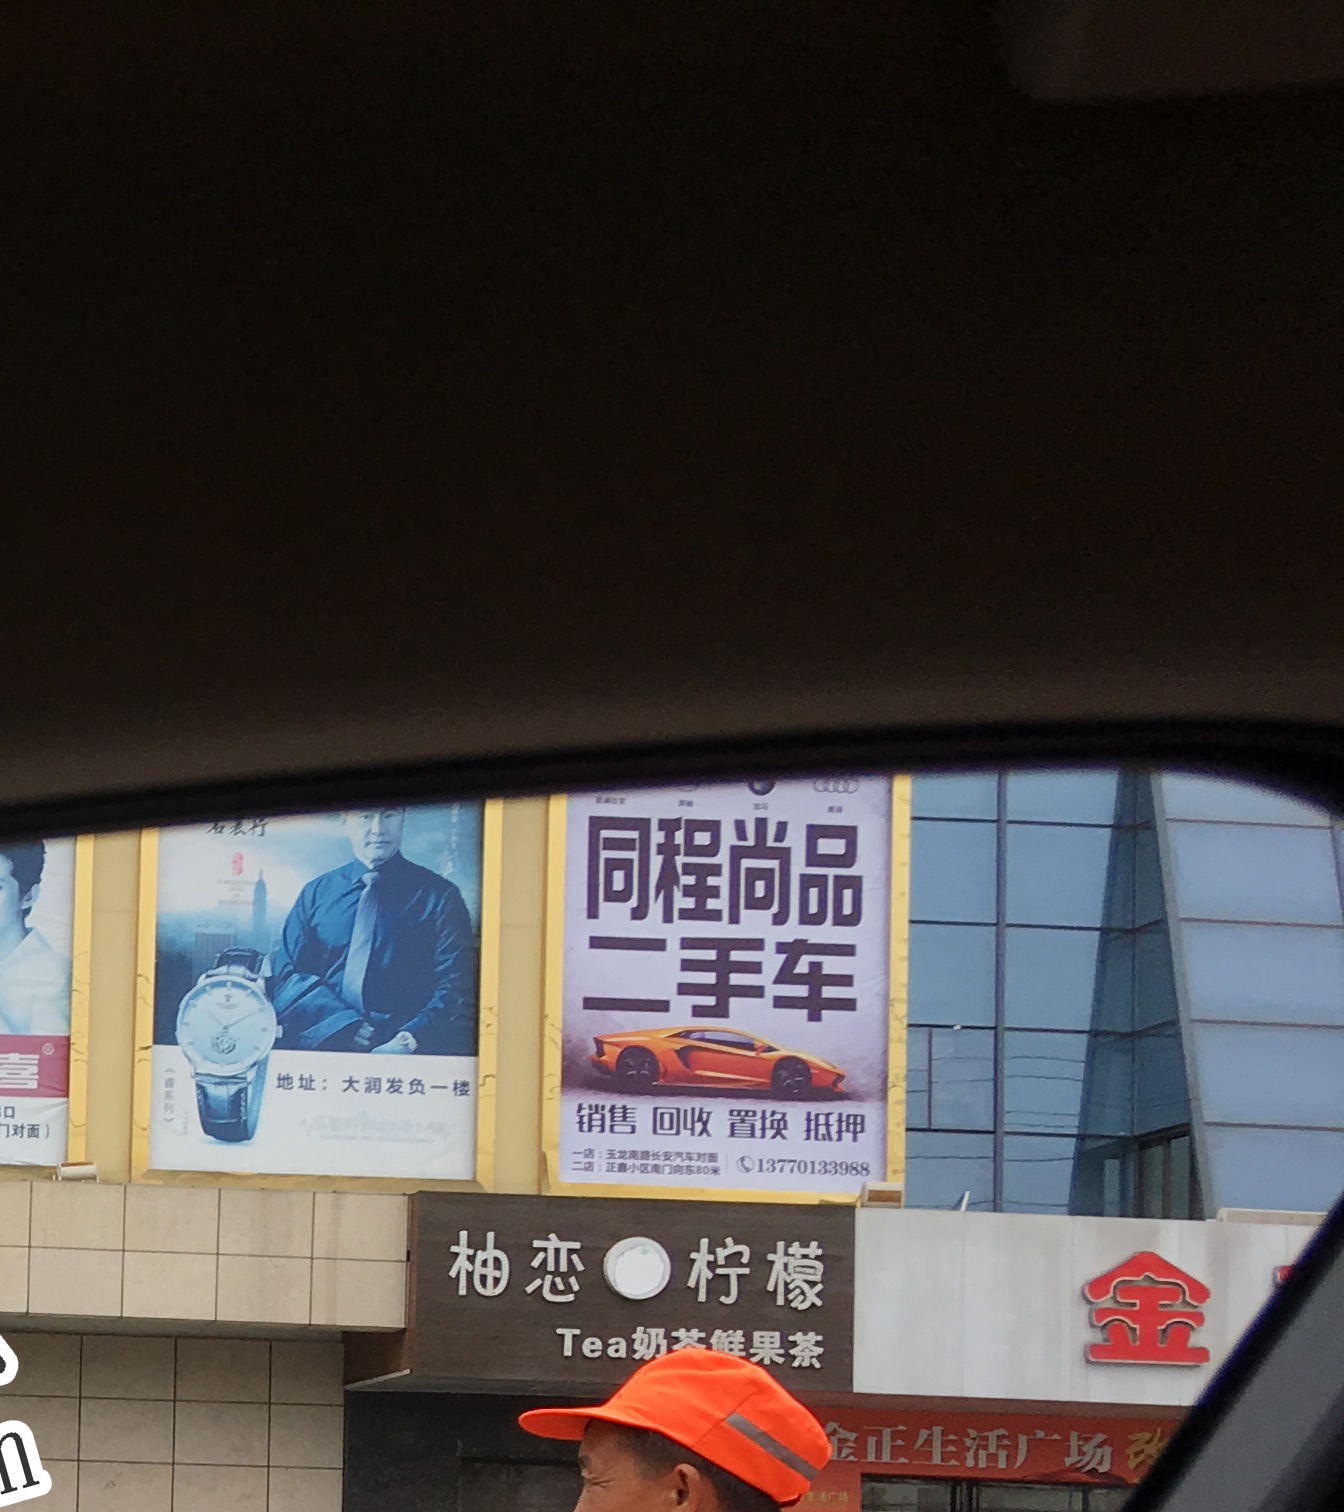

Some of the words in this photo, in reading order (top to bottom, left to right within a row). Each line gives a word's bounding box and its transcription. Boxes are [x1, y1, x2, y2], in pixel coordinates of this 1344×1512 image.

[586, 815, 864, 927] 同程尚品
[582, 935, 858, 1022] 二手车
[576, 1102, 638, 1135] 销售
[651, 1106, 713, 1138] 回收
[727, 1108, 790, 1141] 置换
[804, 1111, 866, 1143] 抵押
[756, 1157, 871, 1177] 13770133988
[447, 1230, 585, 1303] 柚恋
[686, 1236, 825, 1311] 柠檬
[1082, 1251, 1211, 1366] 金
[824, 1421, 1114, 1474] 金正生活广场
